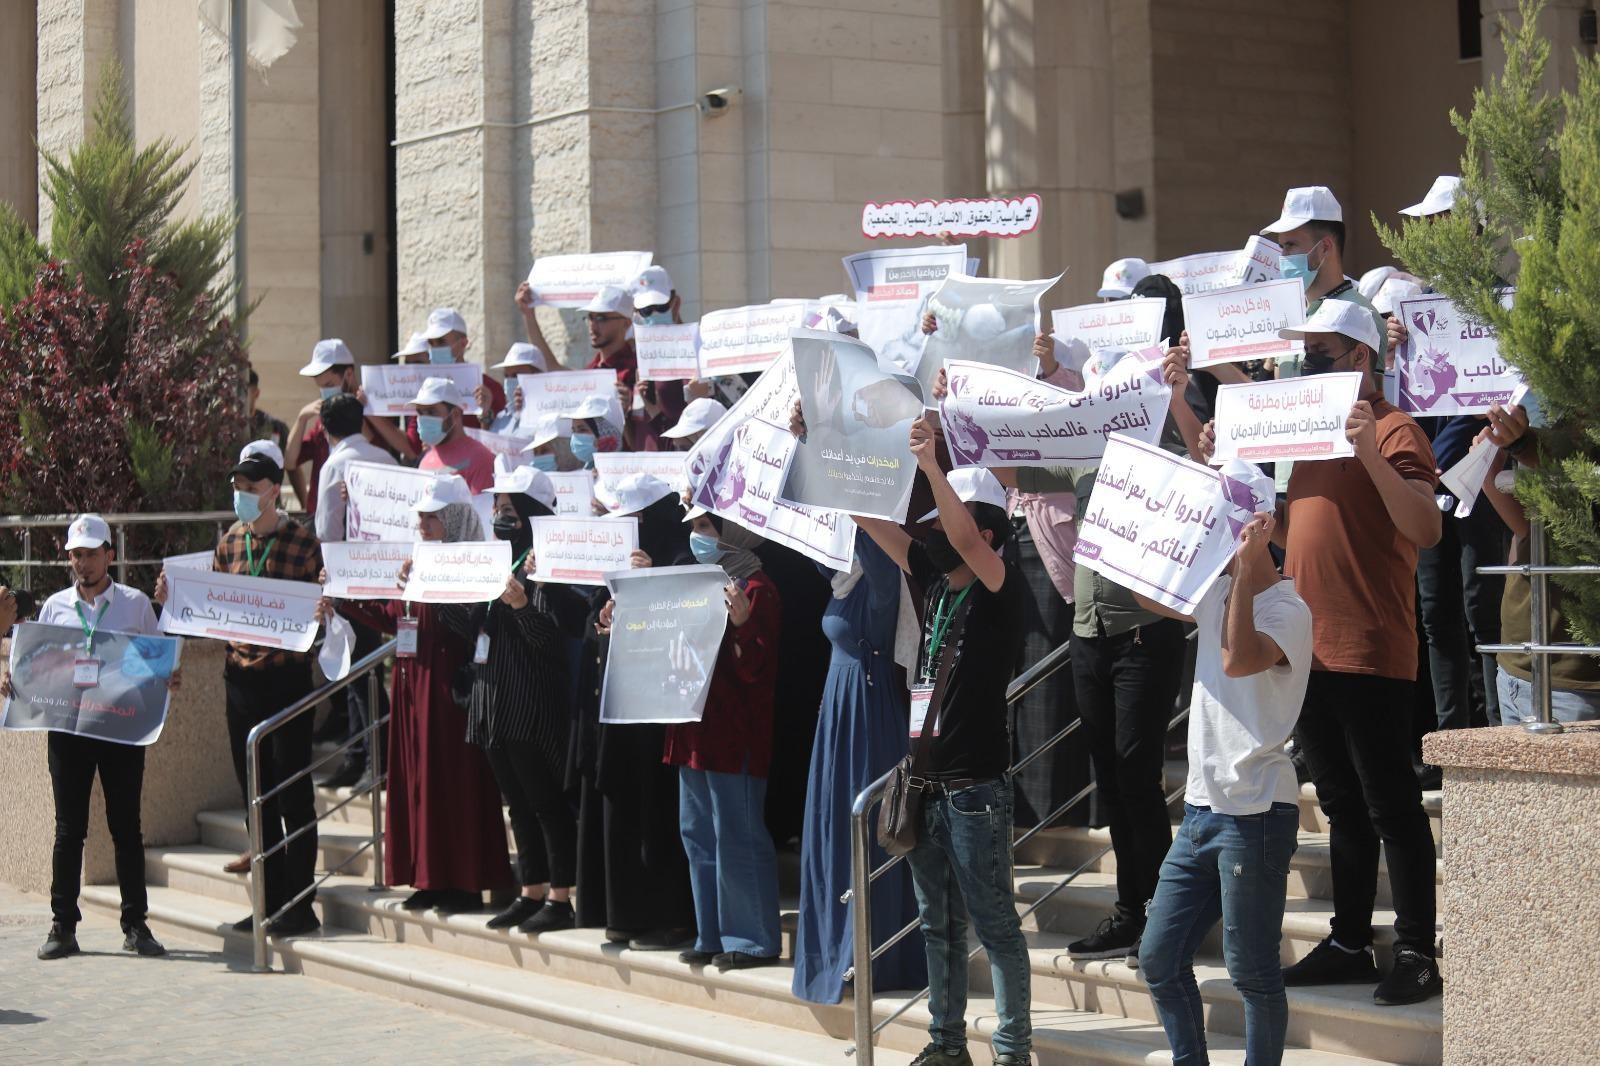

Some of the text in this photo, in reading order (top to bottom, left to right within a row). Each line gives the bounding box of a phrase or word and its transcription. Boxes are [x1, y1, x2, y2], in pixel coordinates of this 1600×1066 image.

[888, 270, 900, 281] من
[935, 267, 948, 277] كن
[1217, 296, 1271, 319] وراء كل مدمن
[1206, 312, 1289, 343] أسرة تعاني وتموت
[1460, 319, 1496, 340] دقاء
[1099, 373, 1142, 402] بادروا
[978, 389, 1027, 408] أصدقاء
[1248, 384, 1324, 412] أبناؤنا بين مطرقة
[989, 423, 1026, 443] ساحب
[1028, 420, 1088, 443] فالصاحب
[1230, 415, 1342, 441] المخدرات وسندان الإدمان
[751, 442, 790, 471] أصدقاء
[821, 448, 900, 469] المخدرات في يد أعدائك
[1095, 464, 1133, 492] أصدقاء
[363, 480, 388, 498] أصدقاء
[388, 486, 407, 504] معرفة
[1145, 488, 1176, 517] إلى
[362, 510, 381, 524] ساحب
[382, 513, 409, 530] فالصاحب
[1175, 493, 1217, 536] بادروا
[588, 528, 610, 548] التحية
[610, 530, 624, 548] كل
[348, 548, 378, 564] وشبابنا
[434, 551, 493, 569] محاربة المخدرات
[336, 567, 395, 581] بيد تجار المخدرات
[207, 587, 286, 611] قضاؤنا الشامخ
[666, 597, 681, 611] أسرع
[681, 597, 709, 610] المخدرات
[181, 606, 310, 635] نعتز ونفتخر بكم
[625, 618, 678, 632] المؤدية إلى الموت
[71, 697, 136, 718] المخدرات
